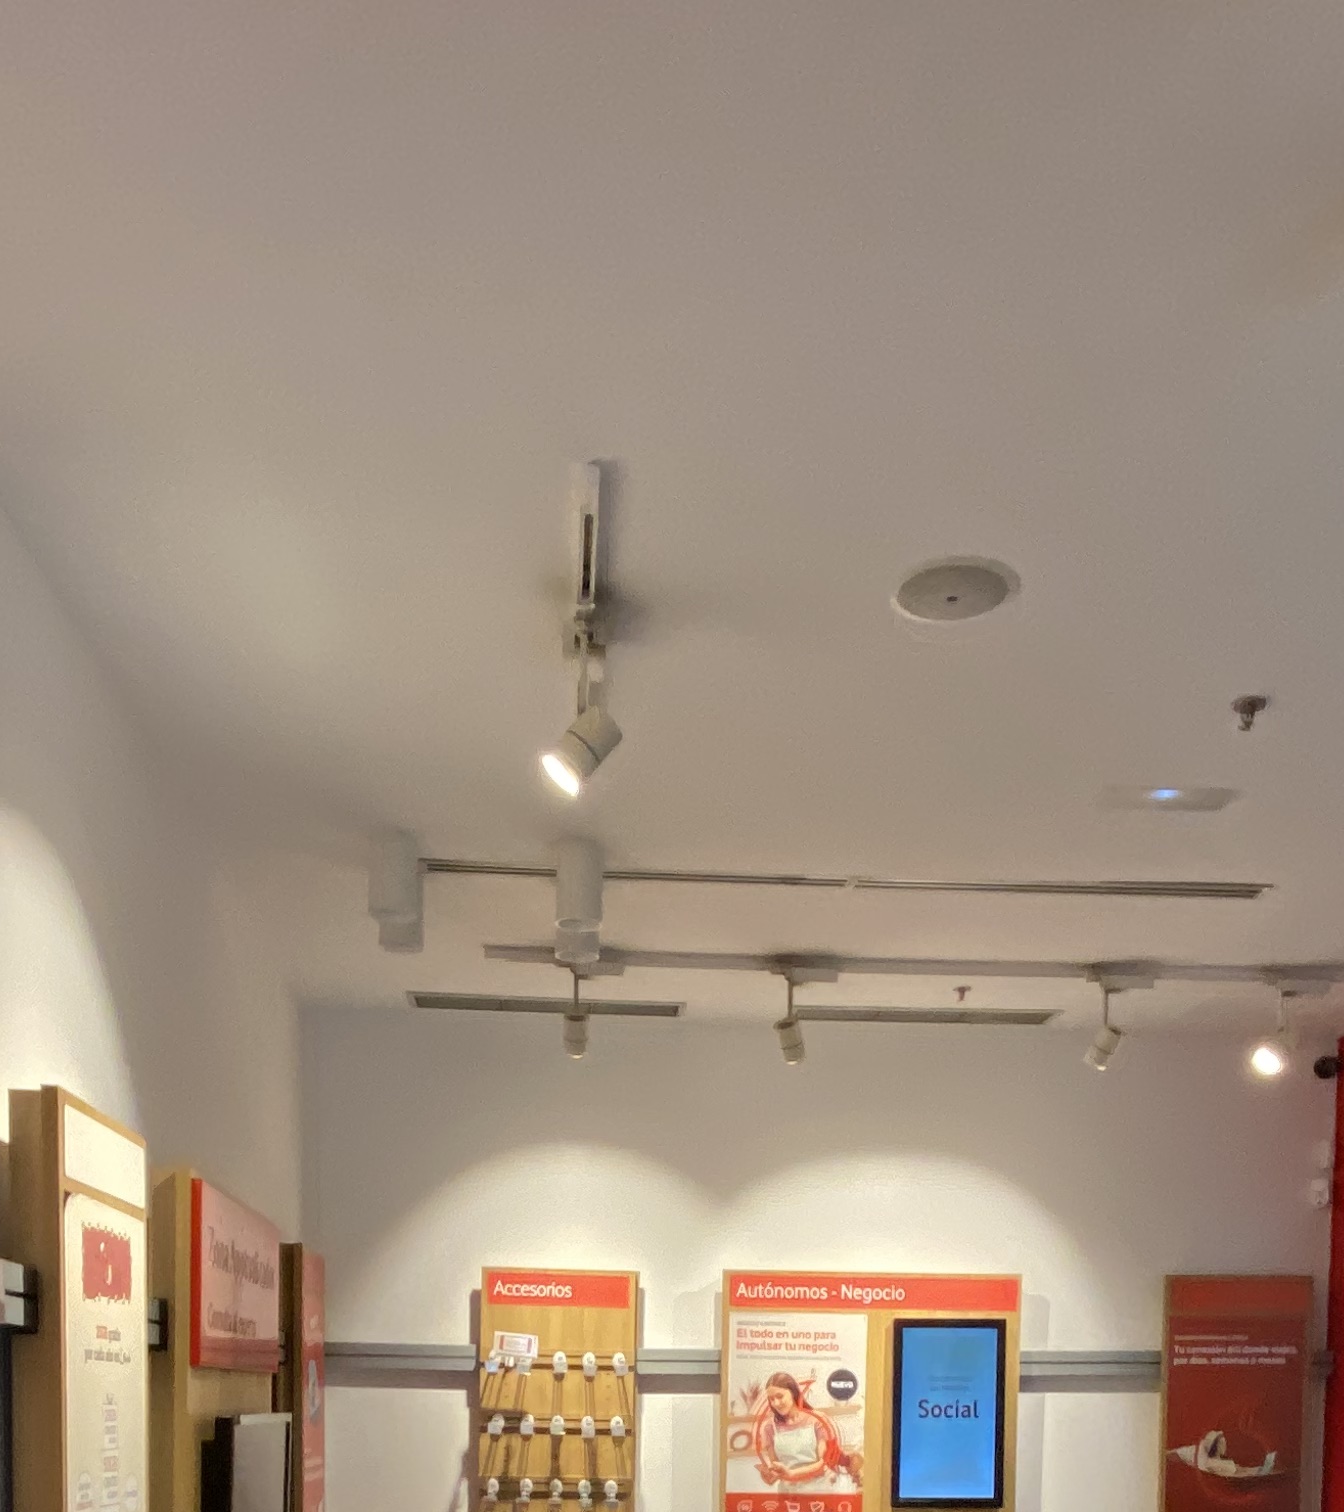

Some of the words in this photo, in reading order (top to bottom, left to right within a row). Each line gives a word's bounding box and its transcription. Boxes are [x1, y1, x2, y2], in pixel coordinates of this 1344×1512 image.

[493, 1280, 573, 1298] Accesorios
[735, 1281, 829, 1301] Autónomos
[840, 1284, 906, 1305] Negocio
[736, 1328, 748, 1339] El
[750, 1329, 774, 1339] todo
[776, 1330, 789, 1339] en
[791, 1331, 812, 1340] uno
[814, 1331, 837, 1342] para
[785, 1341, 797, 1351] tu
[798, 1342, 840, 1354] negocio
[918, 1398, 979, 1419] Social
